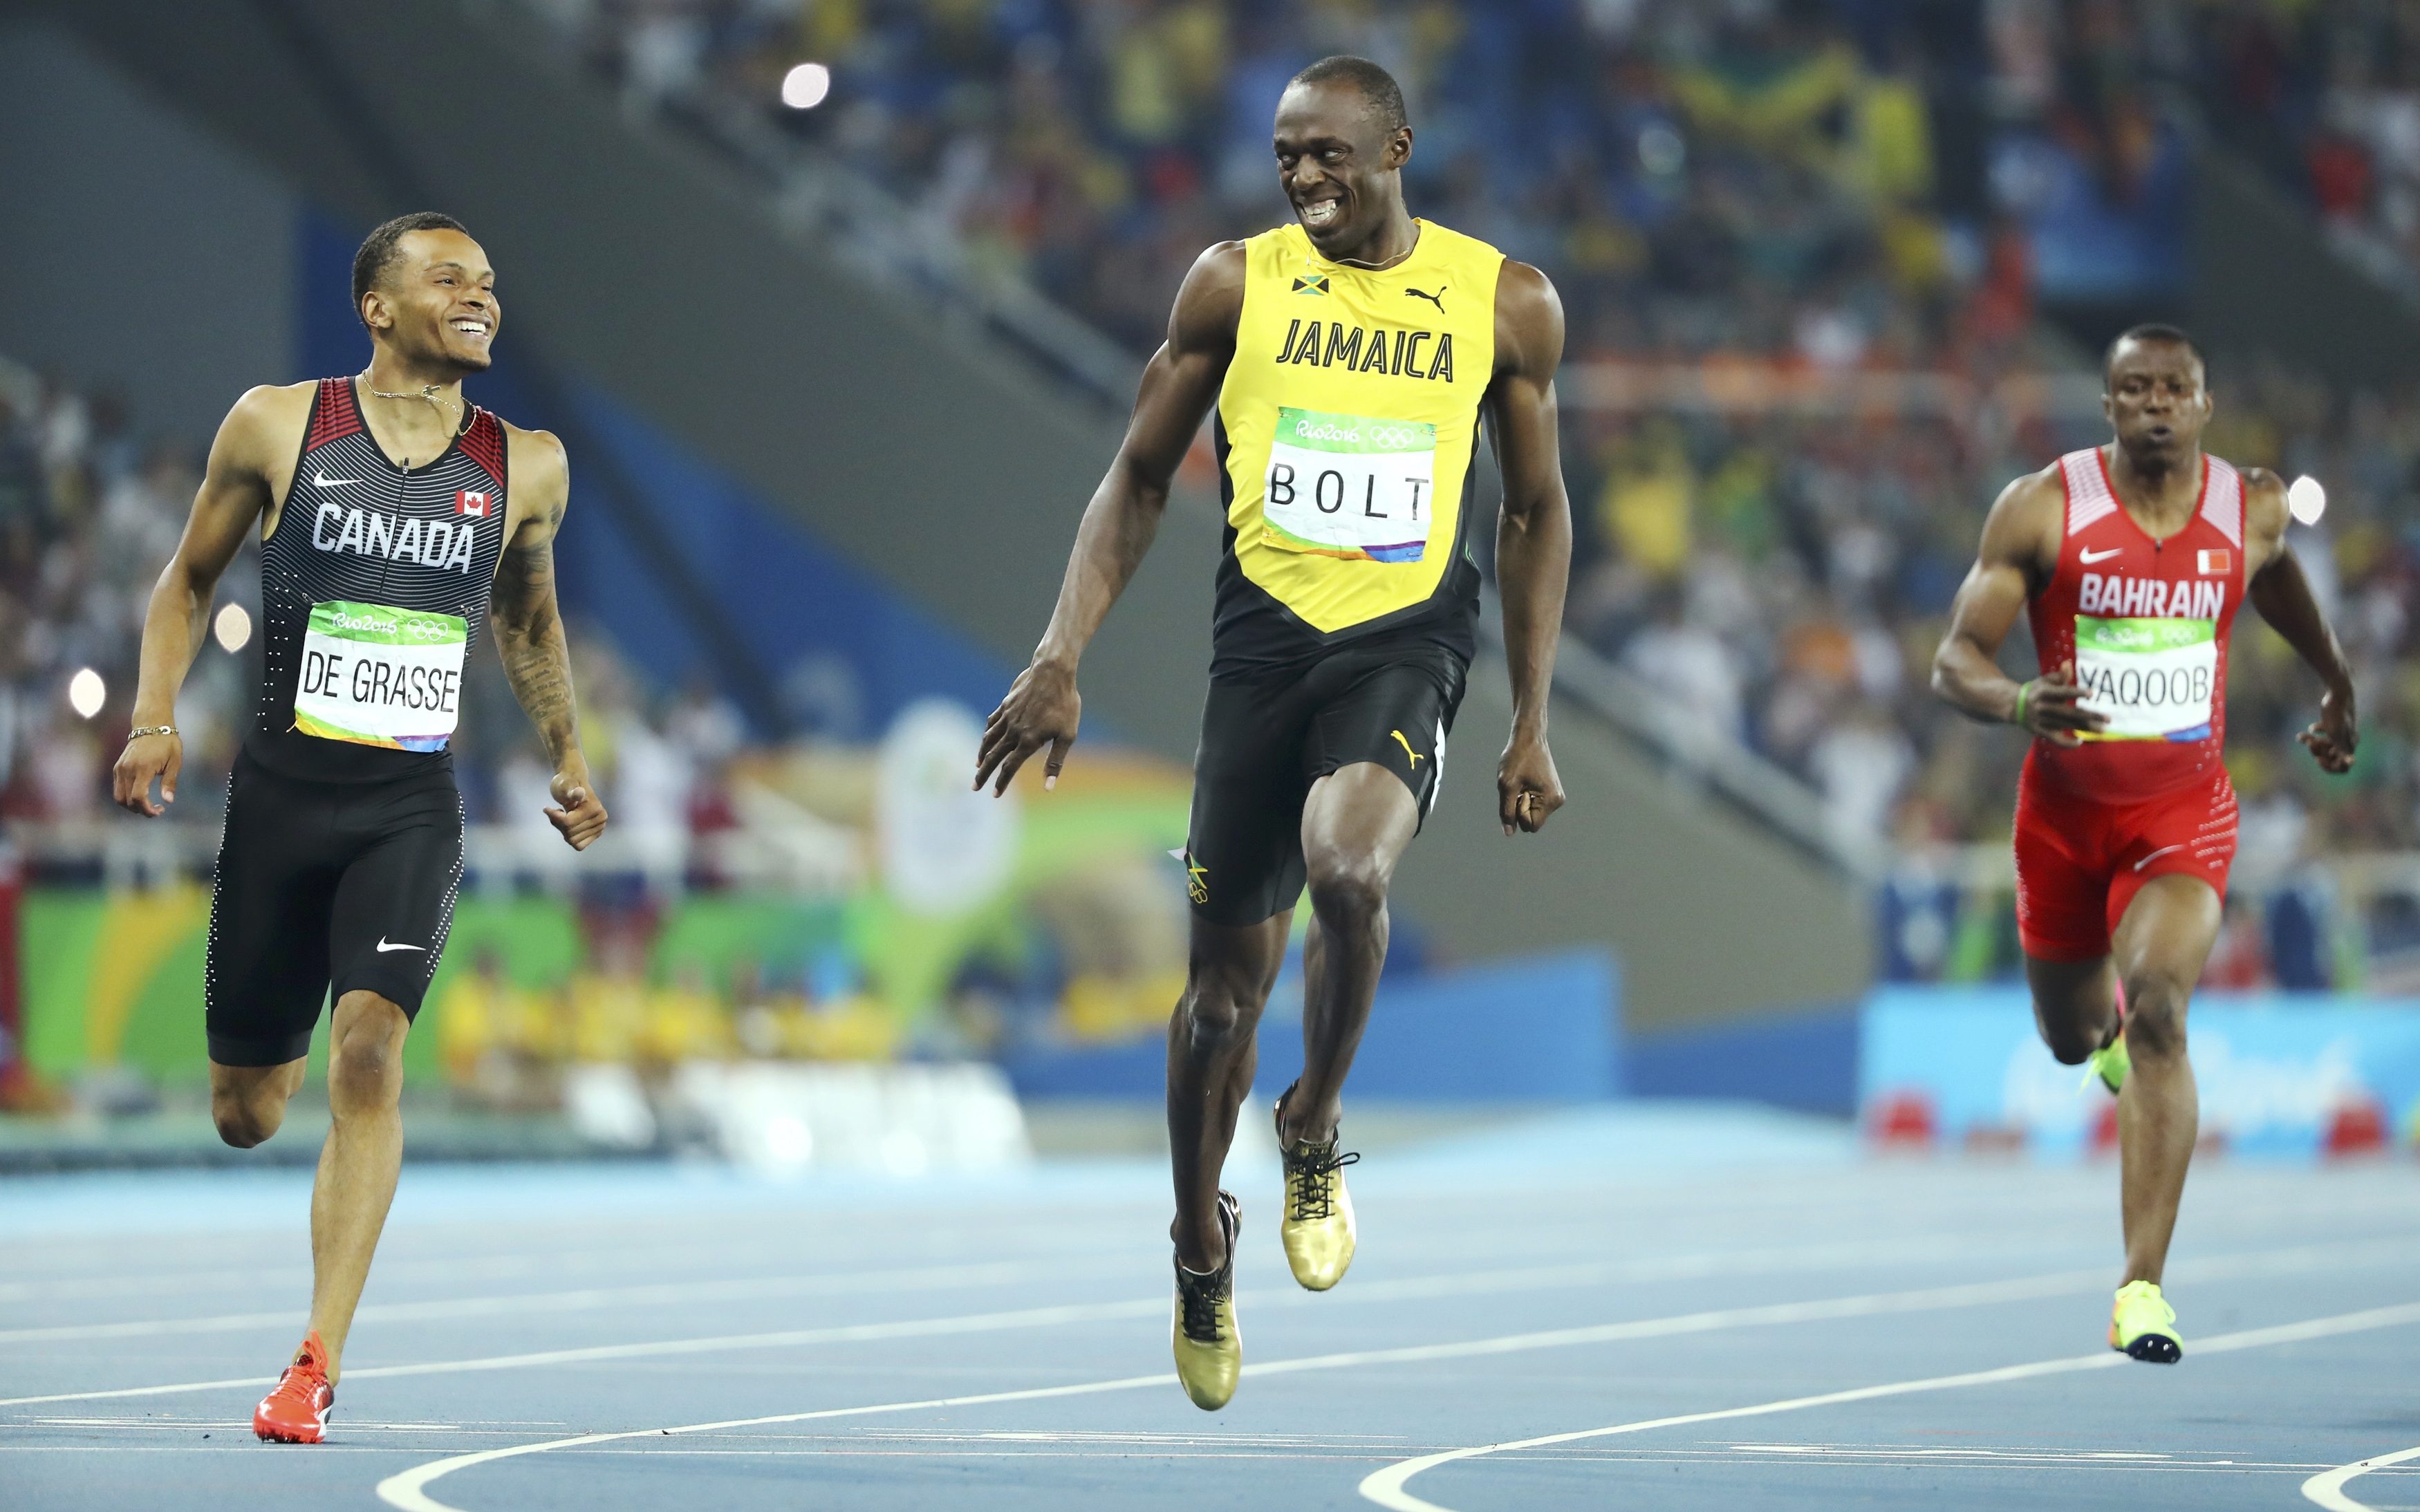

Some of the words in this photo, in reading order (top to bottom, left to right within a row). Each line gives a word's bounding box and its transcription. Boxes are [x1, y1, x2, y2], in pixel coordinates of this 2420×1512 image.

[1276, 318, 1454, 383] JAMAICA
[1296, 420, 1360, 442] Rio2016
[1269, 463, 1429, 521] BOLT
[313, 503, 474, 574] CANADA
[2079, 573, 2225, 620] BAHRAIN
[332, 612, 398, 635] Rio2016
[304, 651, 342, 698] DE
[353, 658, 458, 713] GRASSE
[2080, 665, 2208, 707] YAQOOB
